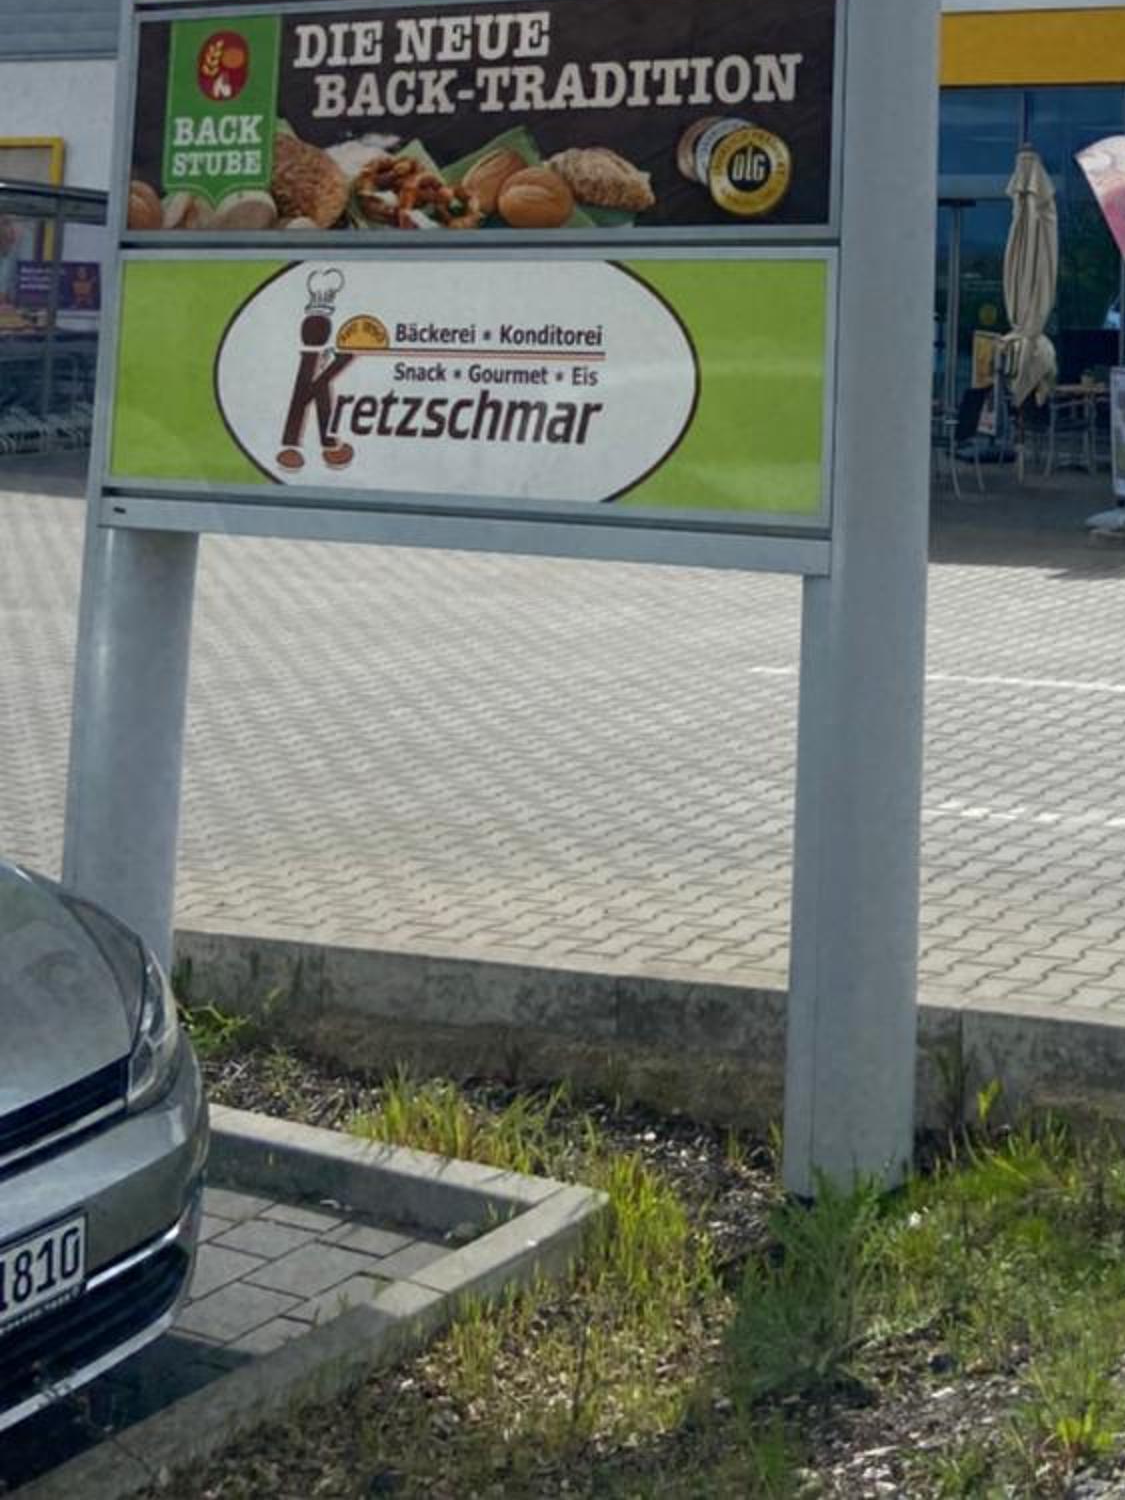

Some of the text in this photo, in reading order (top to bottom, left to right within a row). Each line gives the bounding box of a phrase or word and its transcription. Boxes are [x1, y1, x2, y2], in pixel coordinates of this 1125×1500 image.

[293, 11, 551, 69] DIE NEUE
[312, 53, 803, 118] BACK-TRADITION
[173, 115, 264, 146] BACK
[172, 149, 262, 177] STUBE
[395, 322, 477, 344] Bäckerei
[499, 323, 604, 347] Konditorei
[393, 362, 599, 387] Snack Gourmet Eis
[281, 350, 604, 446] Kretzschmar
